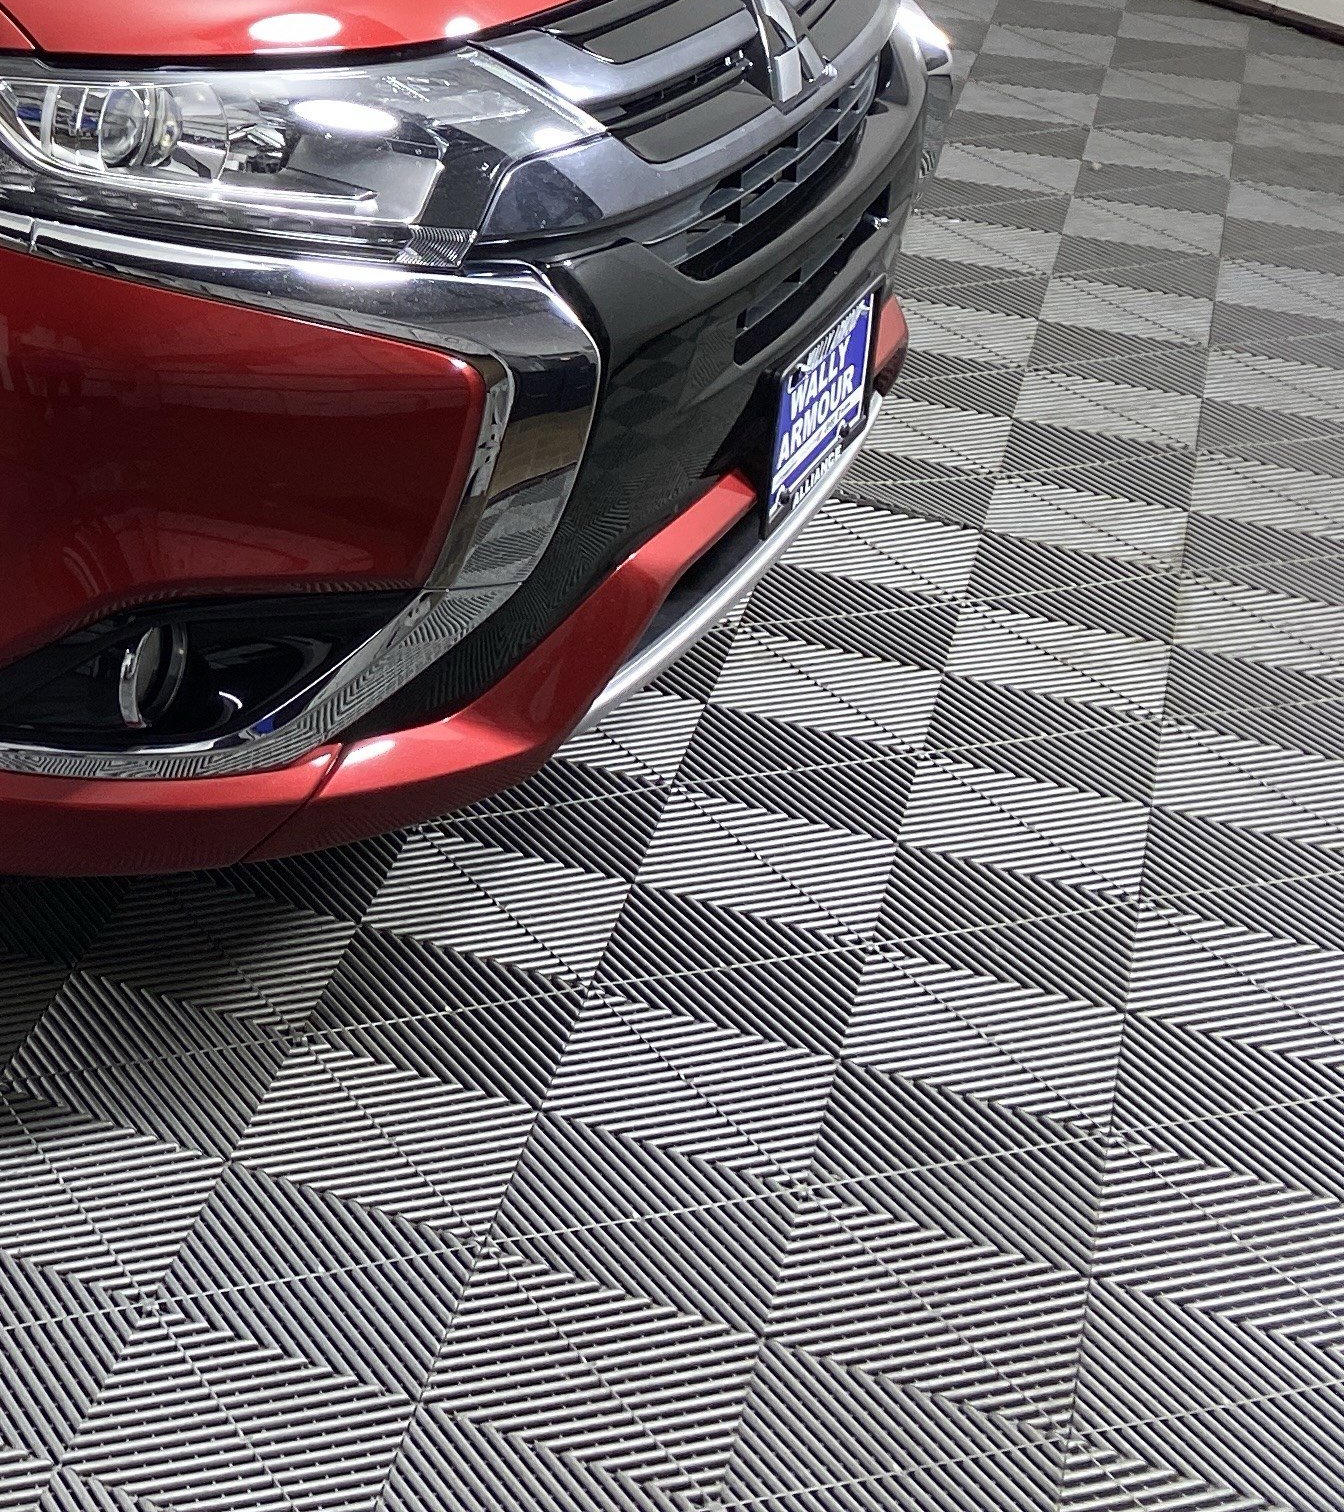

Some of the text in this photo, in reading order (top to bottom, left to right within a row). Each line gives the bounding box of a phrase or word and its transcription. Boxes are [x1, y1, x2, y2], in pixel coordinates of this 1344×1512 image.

[777, 365, 854, 470] ARMOUR
[791, 335, 851, 420] WALLY
[793, 444, 842, 509] ALLIANCE
